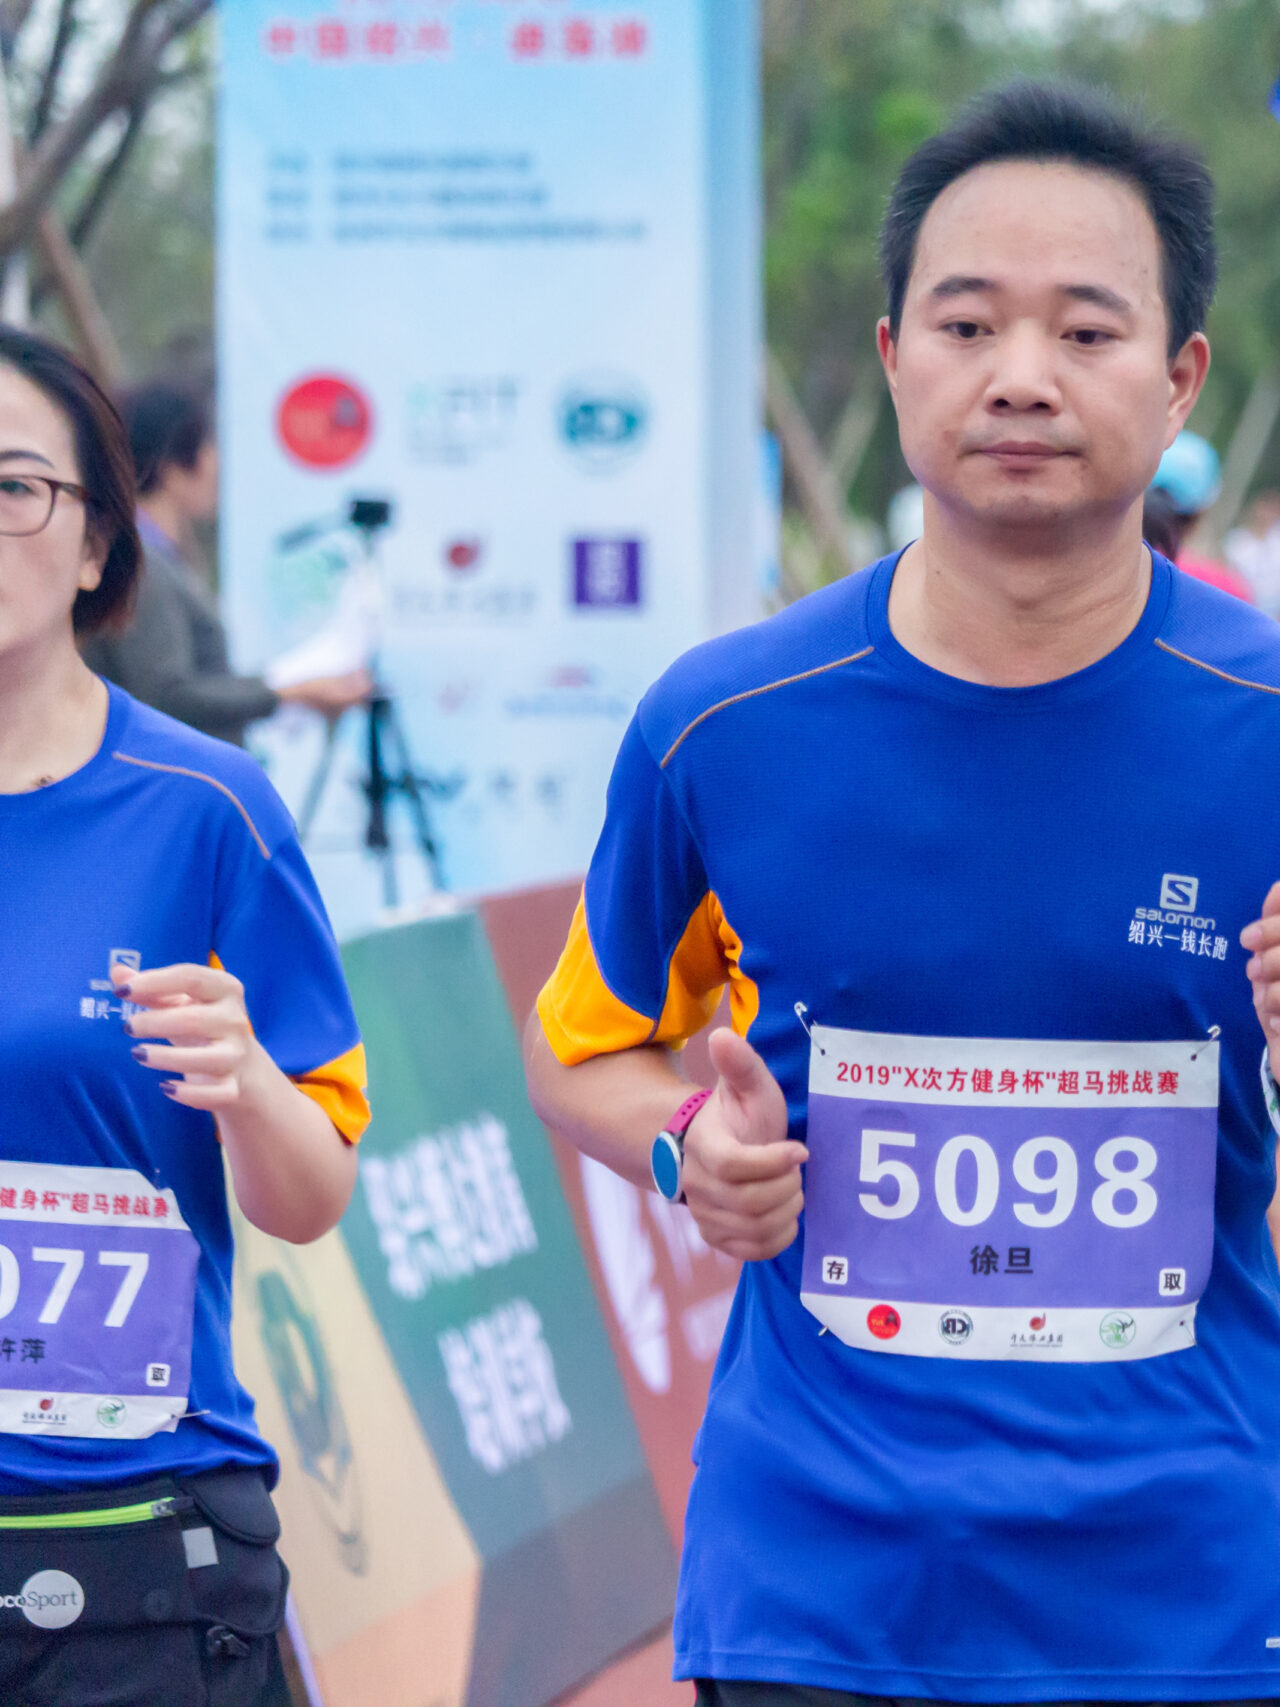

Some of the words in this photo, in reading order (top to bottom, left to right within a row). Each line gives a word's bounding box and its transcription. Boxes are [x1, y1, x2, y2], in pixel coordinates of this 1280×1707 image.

[1127, 919, 1229, 961] 绍兴一线长跑
[858, 1128, 1158, 1229] 5098
[827, 1260, 846, 1280] 存
[969, 1244, 1034, 1276] 徐旦
[1163, 1272, 1181, 1292] 取
